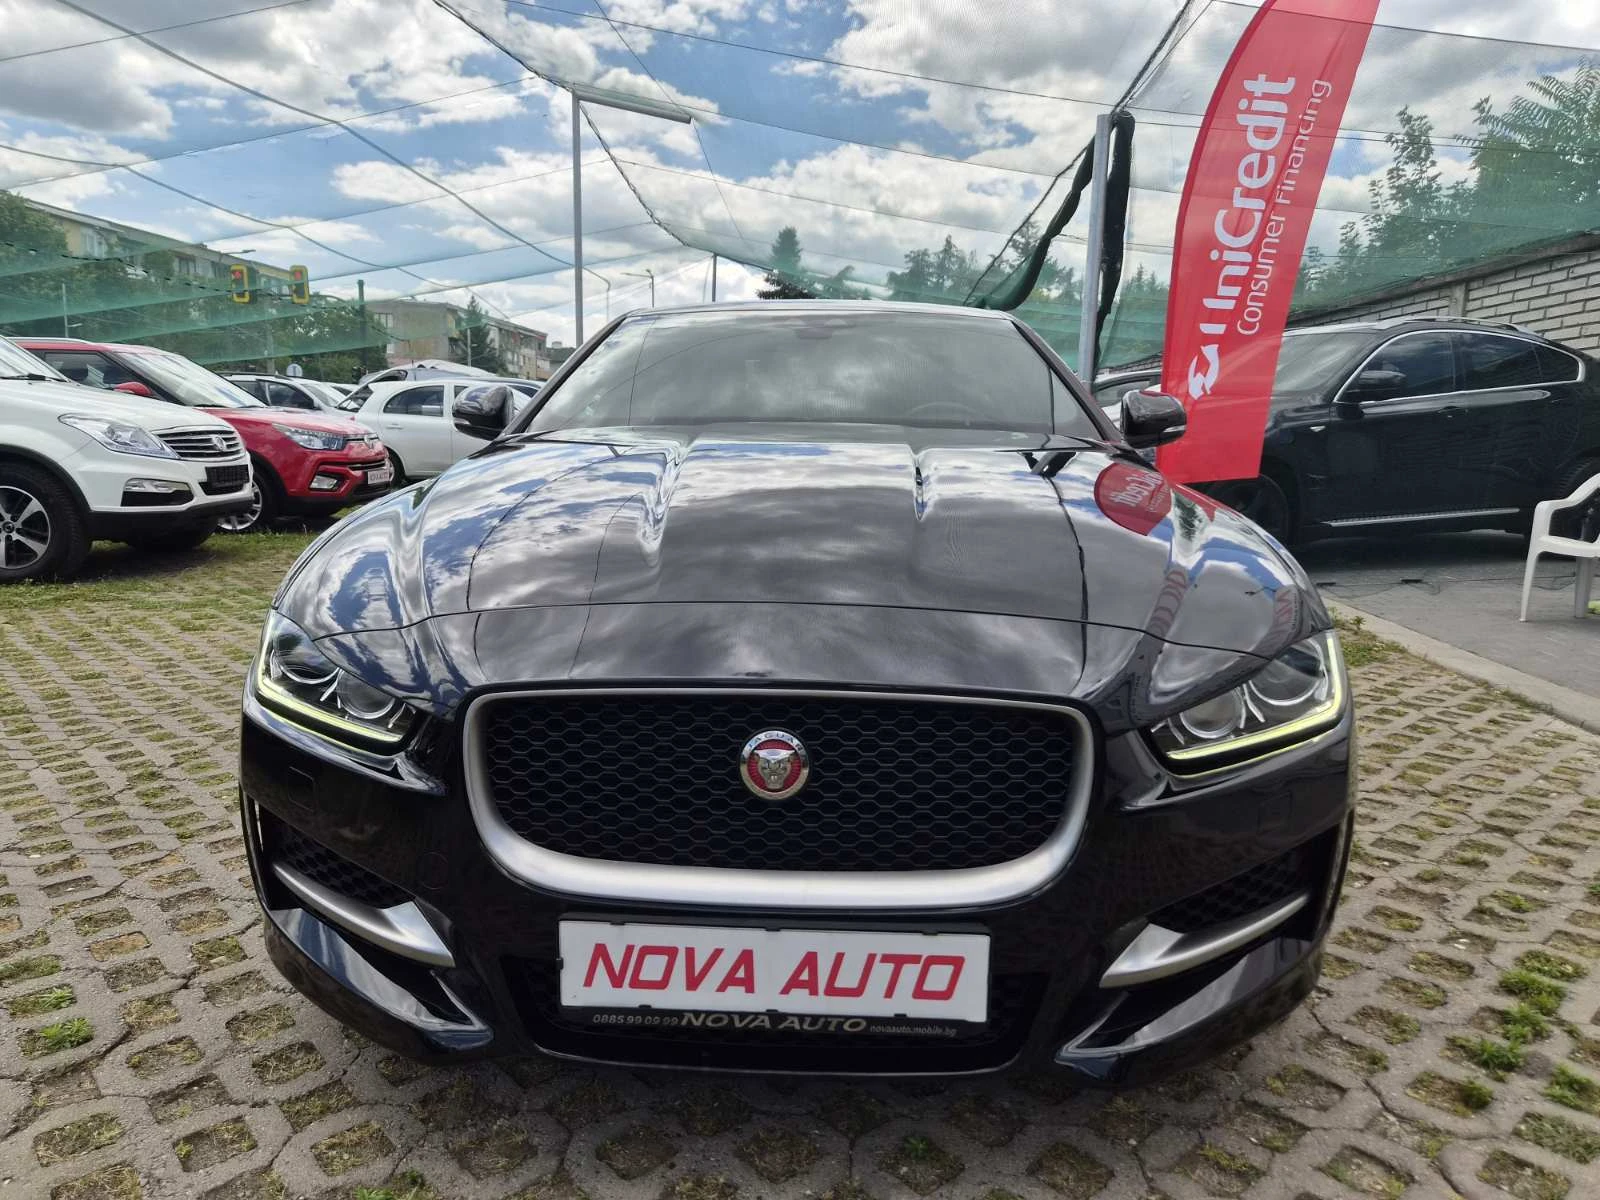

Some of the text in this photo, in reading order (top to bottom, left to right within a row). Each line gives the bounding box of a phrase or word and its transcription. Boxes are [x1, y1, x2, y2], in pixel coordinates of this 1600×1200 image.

[1237, 79, 1332, 335] Consumer Financing
[748, 732, 804, 752] JAGUAR
[582, 943, 966, 1001] NOVA AUTO
[592, 1014, 624, 1024] 0885
[680, 1012, 771, 1029] NOVA
[779, 1016, 867, 1032] AUTO
